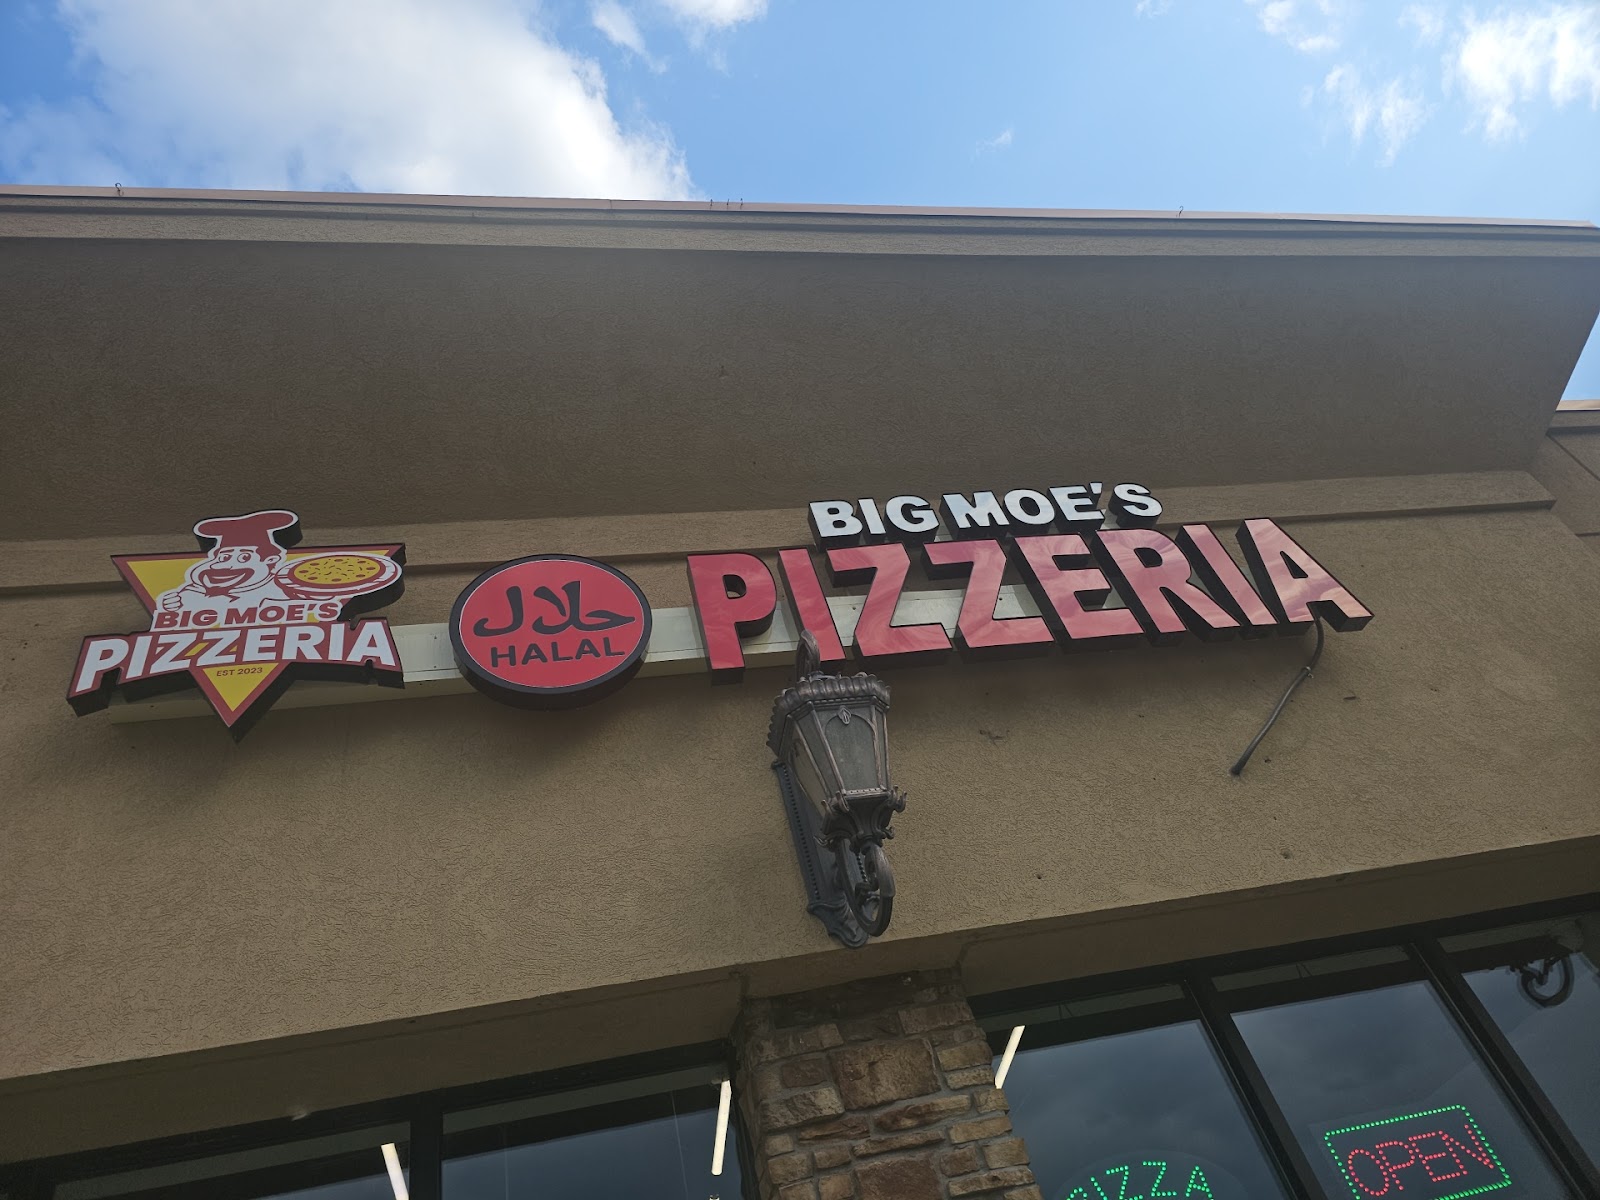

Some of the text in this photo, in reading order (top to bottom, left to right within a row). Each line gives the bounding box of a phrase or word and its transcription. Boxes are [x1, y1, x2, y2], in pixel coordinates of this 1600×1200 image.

[809, 482, 1163, 538] BIG MOE'S
[154, 602, 339, 629] BIG MOE'S
[473, 580, 636, 637] حلال
[687, 518, 1374, 670] PIZZERIA
[76, 621, 396, 692] PIZZERIA
[216, 666, 263, 677] EST 2023
[491, 637, 625, 667] HALAL
[1347, 1123, 1494, 1196] OPEN
